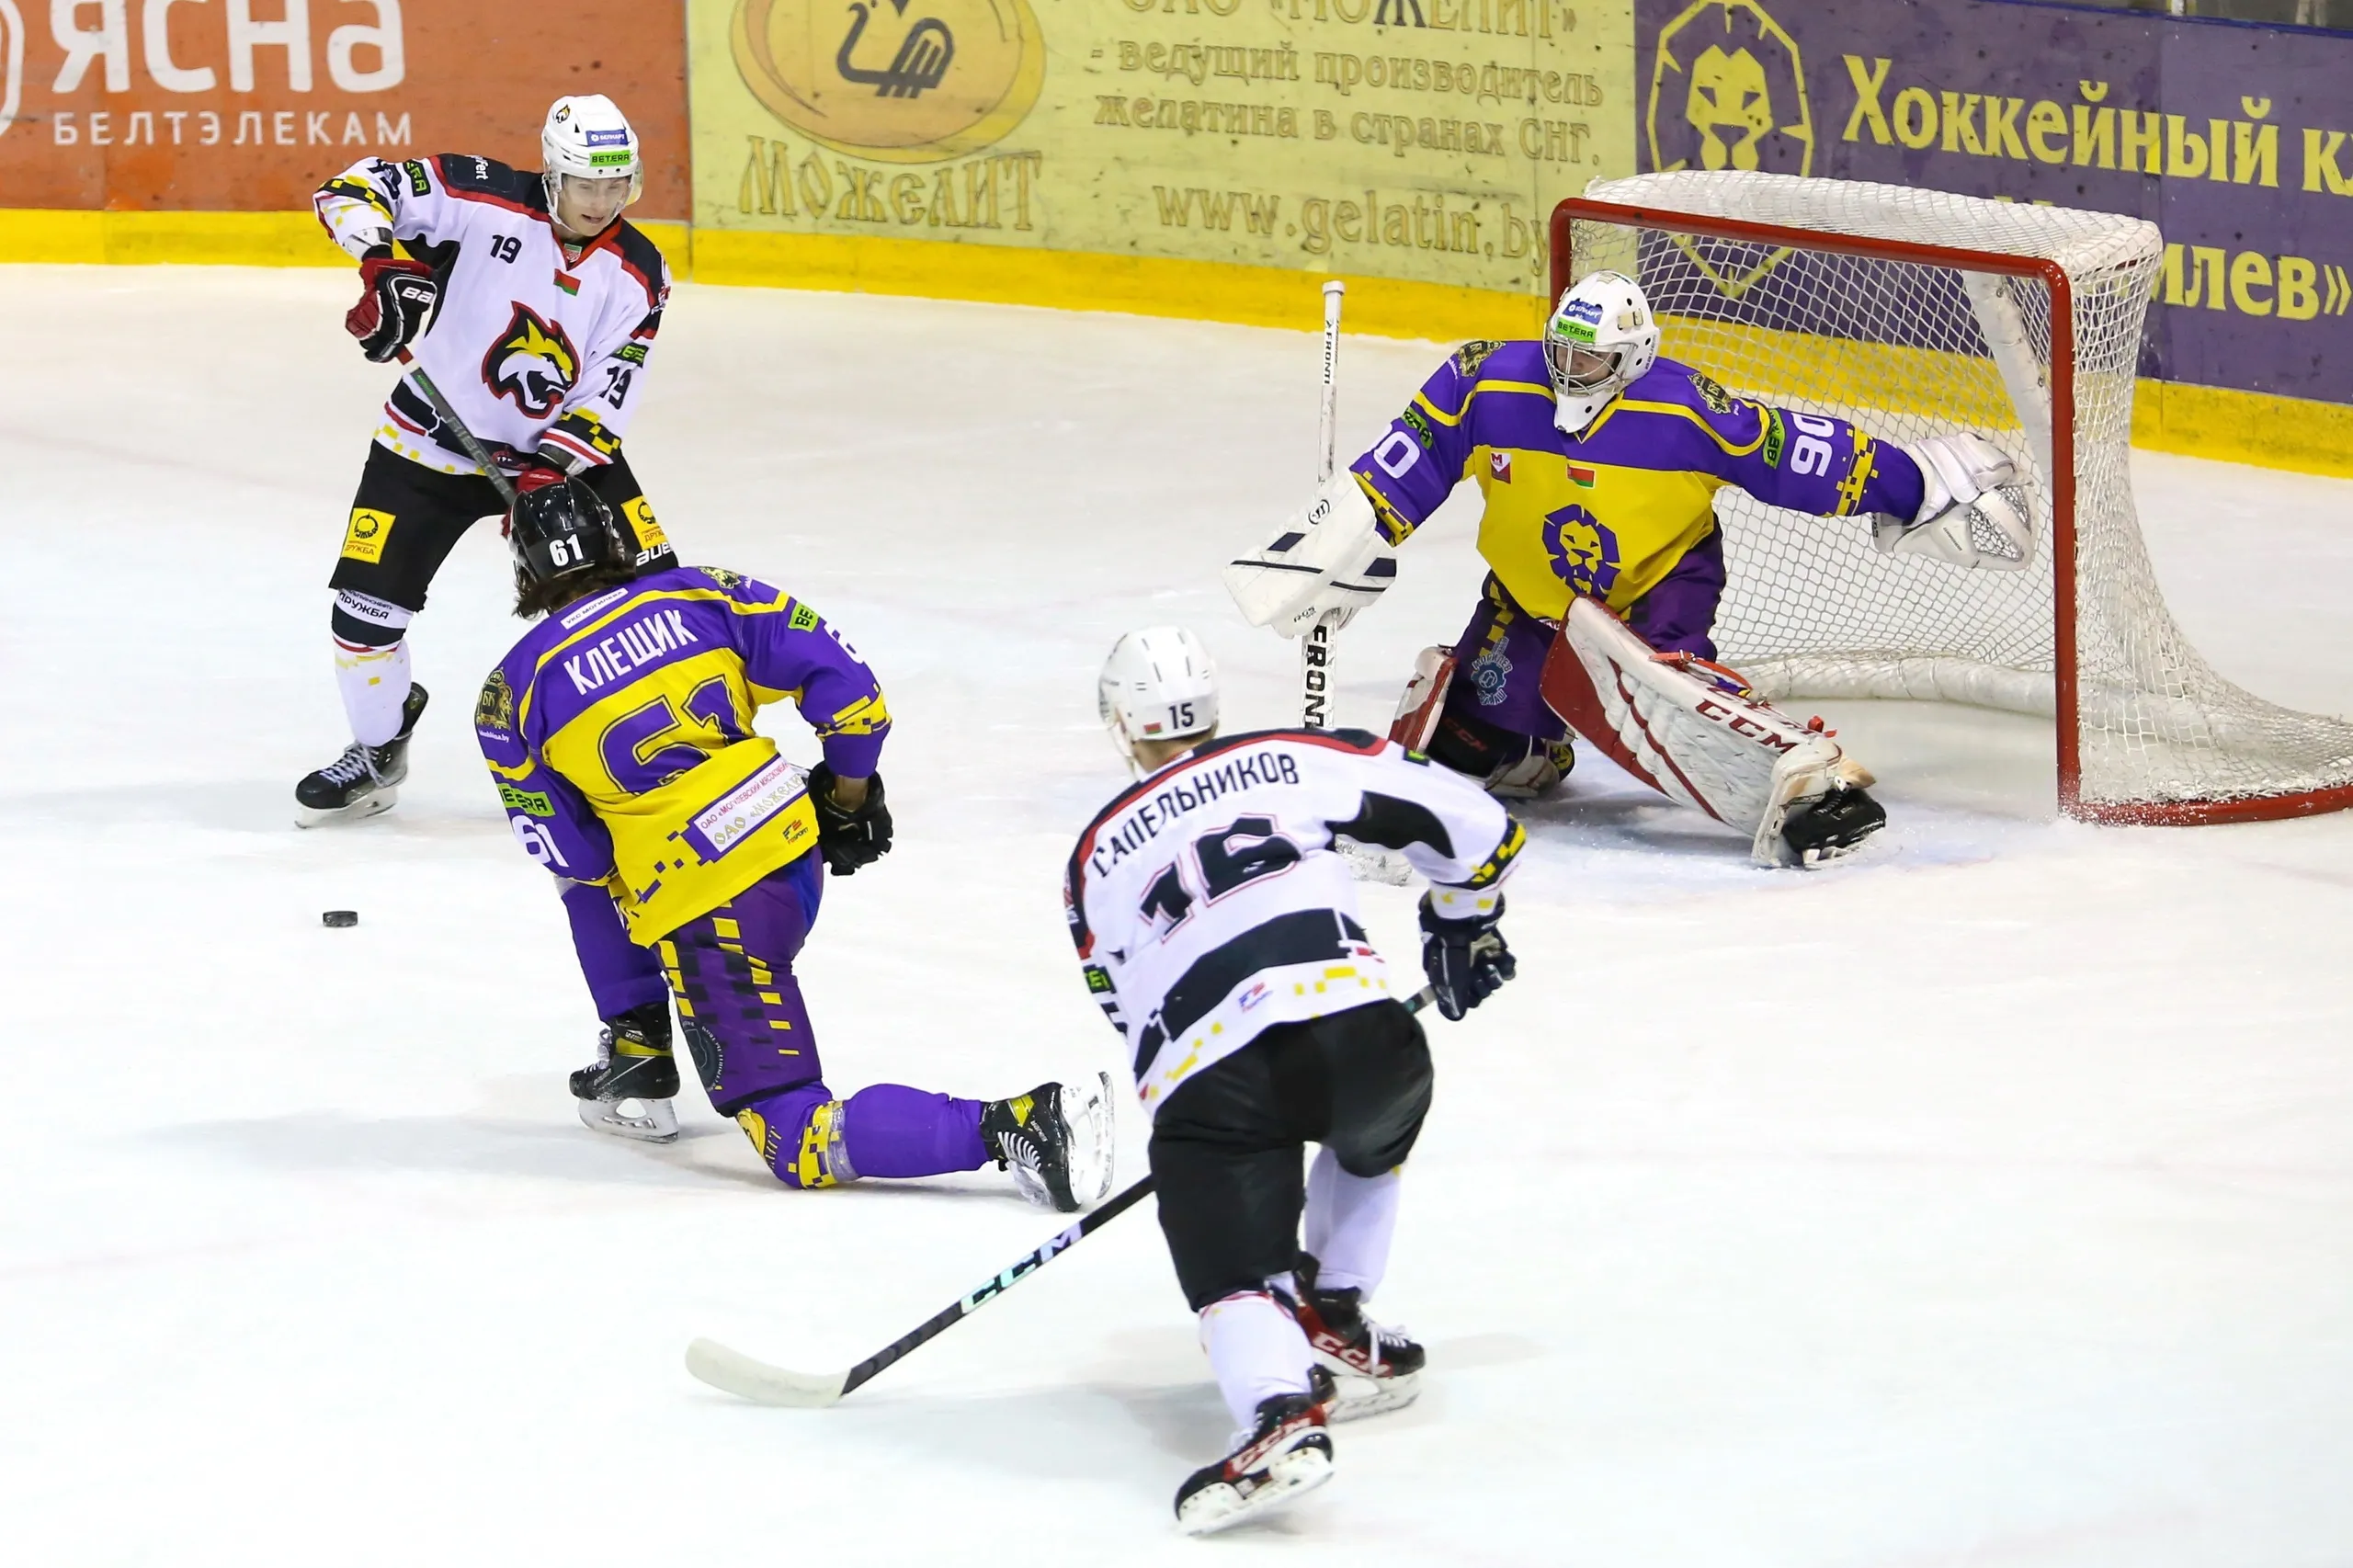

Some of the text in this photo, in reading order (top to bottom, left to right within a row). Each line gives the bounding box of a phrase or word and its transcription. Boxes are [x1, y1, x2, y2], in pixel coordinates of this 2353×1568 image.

[1119, 40, 1603, 108] ведущий производитель
[53, 111, 412, 145] БЕЛТЭЛЕКАМ
[1094, 93, 1600, 166] желатина в странах СНГ.
[1841, 54, 2279, 187] Хоккейный
[591, 153, 630, 164] BETERA
[738, 135, 1041, 231] МОЖЕЛИТ
[489, 234, 522, 264] 19
[1153, 186, 1550, 277] www.gelatin.by
[1557, 321, 1595, 339] BETERA
[598, 366, 631, 410] 19
[1371, 424, 1421, 479] 0
[549, 533, 585, 567] 61
[563, 609, 699, 696] КЛЕЩИК
[1167, 701, 1195, 730] 15
[1696, 699, 1799, 754] CCM
[511, 814, 570, 869] 61
[714, 816, 746, 845] ОАО
[1092, 752, 1300, 878] САПЕЛЬНИКОВ
[961, 1221, 1086, 1314] CCM
